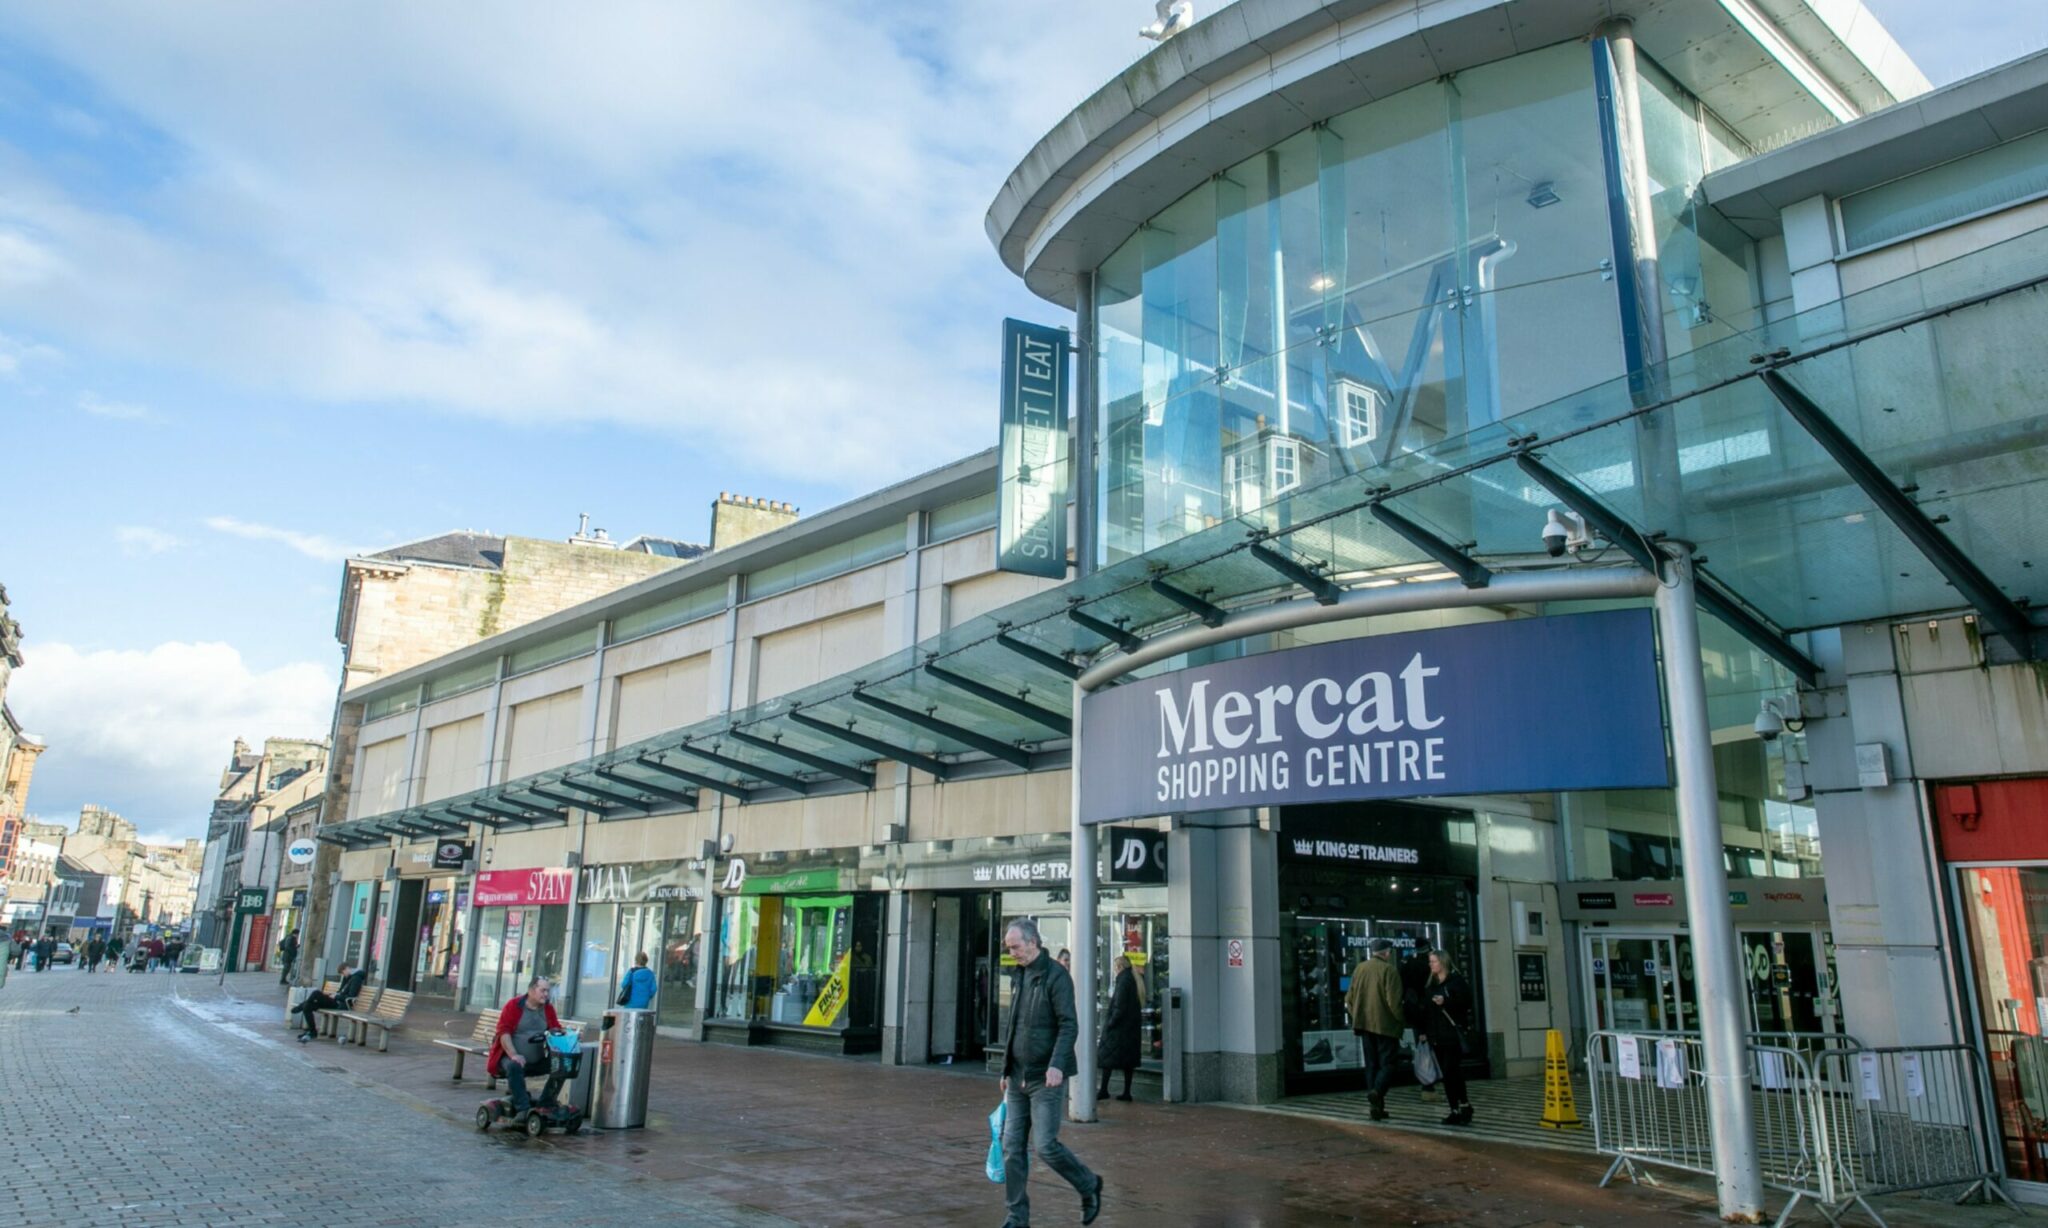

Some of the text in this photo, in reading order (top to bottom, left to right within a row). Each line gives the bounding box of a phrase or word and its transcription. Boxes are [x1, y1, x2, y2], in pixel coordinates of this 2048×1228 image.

[1023, 335, 1052, 380] EAT
[1155, 652, 1445, 758] Mercat
[1157, 737, 1446, 802] SHOPPING CENTRE
[1114, 838, 1147, 870] JD
[1315, 840, 1419, 864] KING OF TRAINERS
[527, 870, 573, 901] SYAN
[583, 866, 633, 900] MAN
[721, 858, 746, 889] JD
[995, 864, 1031, 881] KING
[1031, 863, 1046, 879] OF
[818, 977, 845, 1017] FINAL
